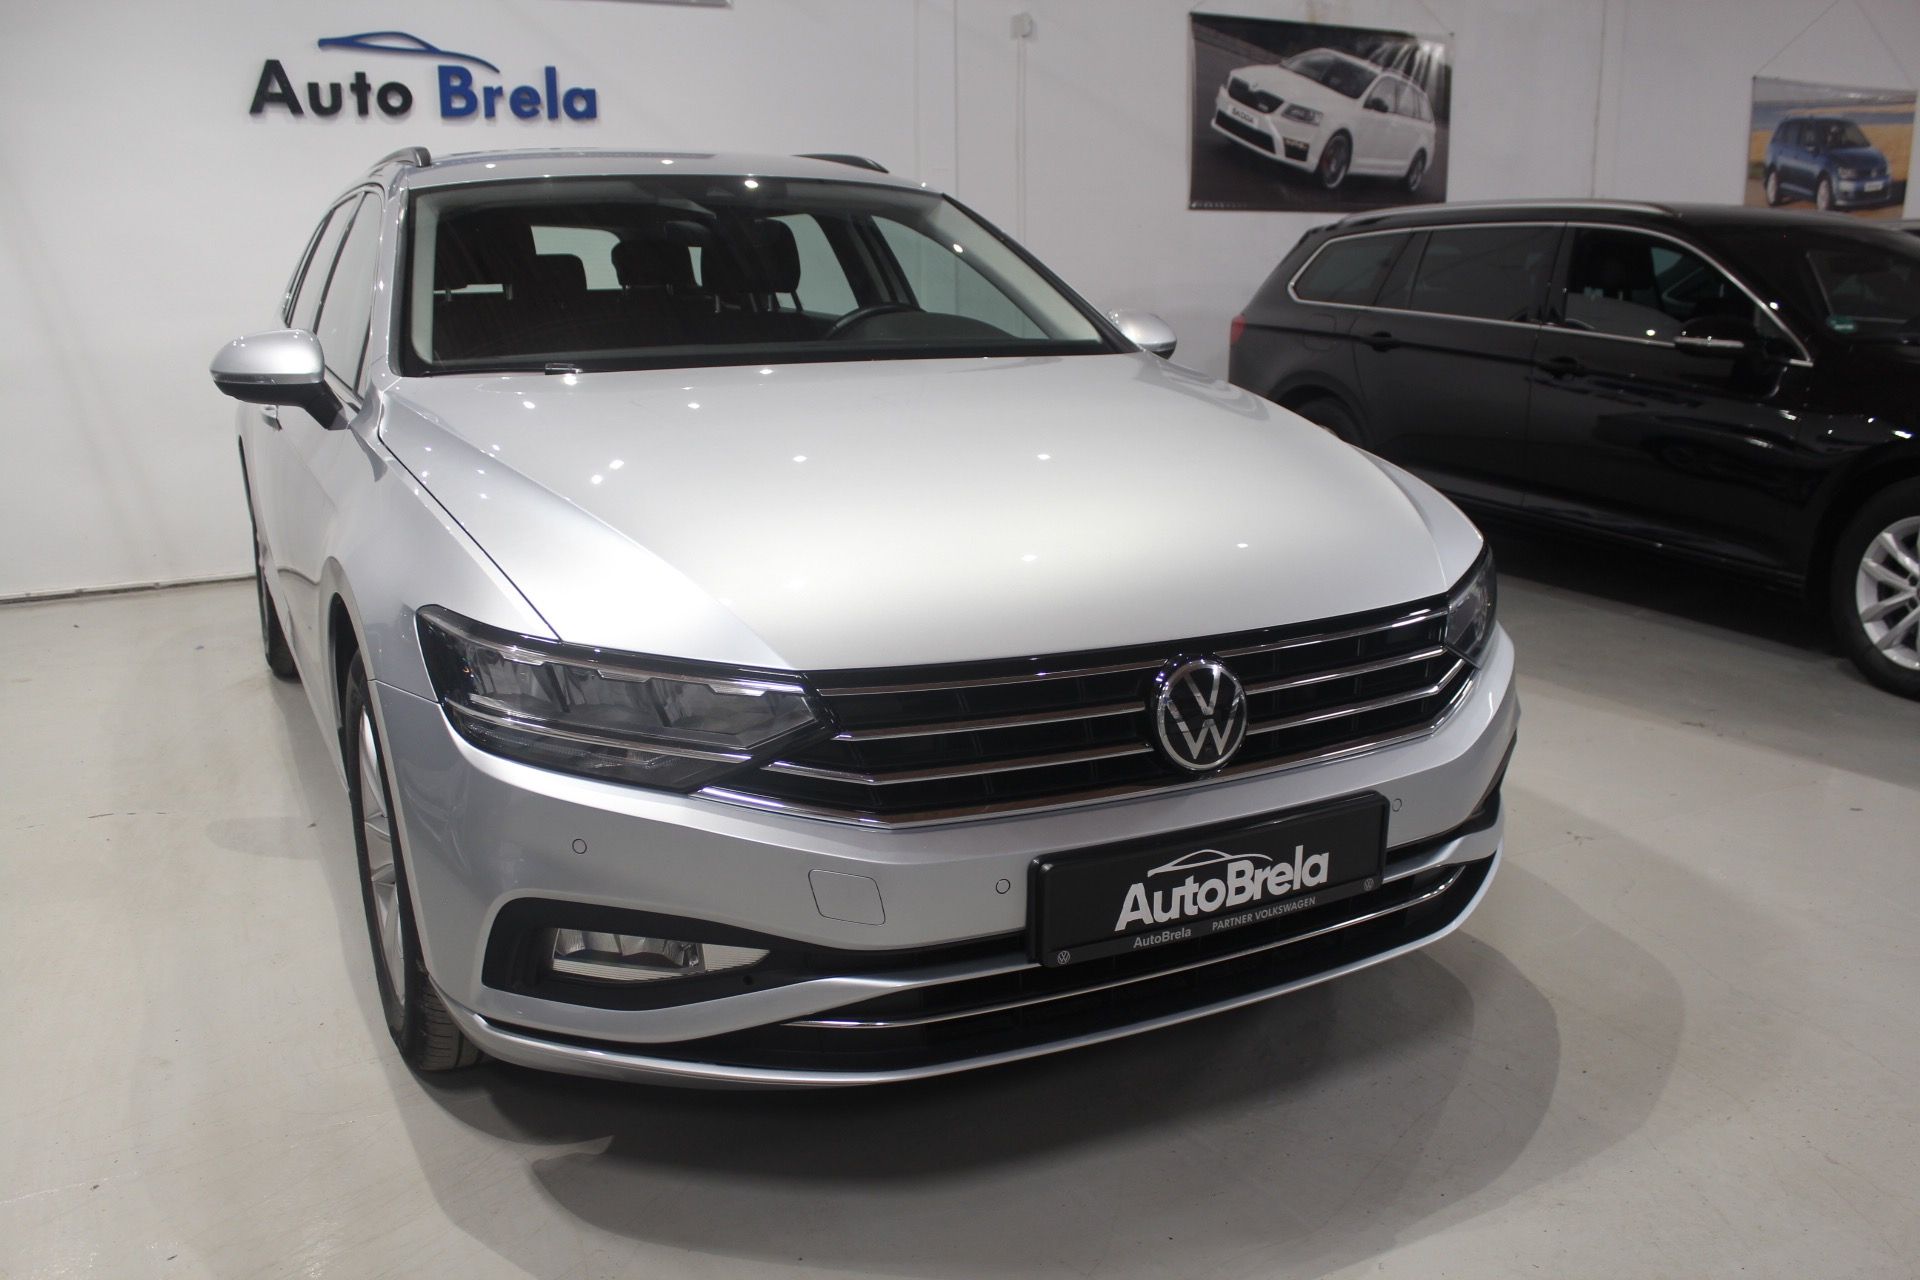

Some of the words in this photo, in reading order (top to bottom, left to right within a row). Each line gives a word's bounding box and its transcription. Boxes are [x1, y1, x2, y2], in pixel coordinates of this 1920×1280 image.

[249, 59, 414, 117] Auto
[437, 65, 598, 121] Brela
[1114, 844, 1330, 932] AutoBrela
[1132, 927, 1192, 949] AutoBrela
[1211, 912, 1254, 932] PARTNER
[1254, 896, 1317, 921] VOLKSWAGEN
